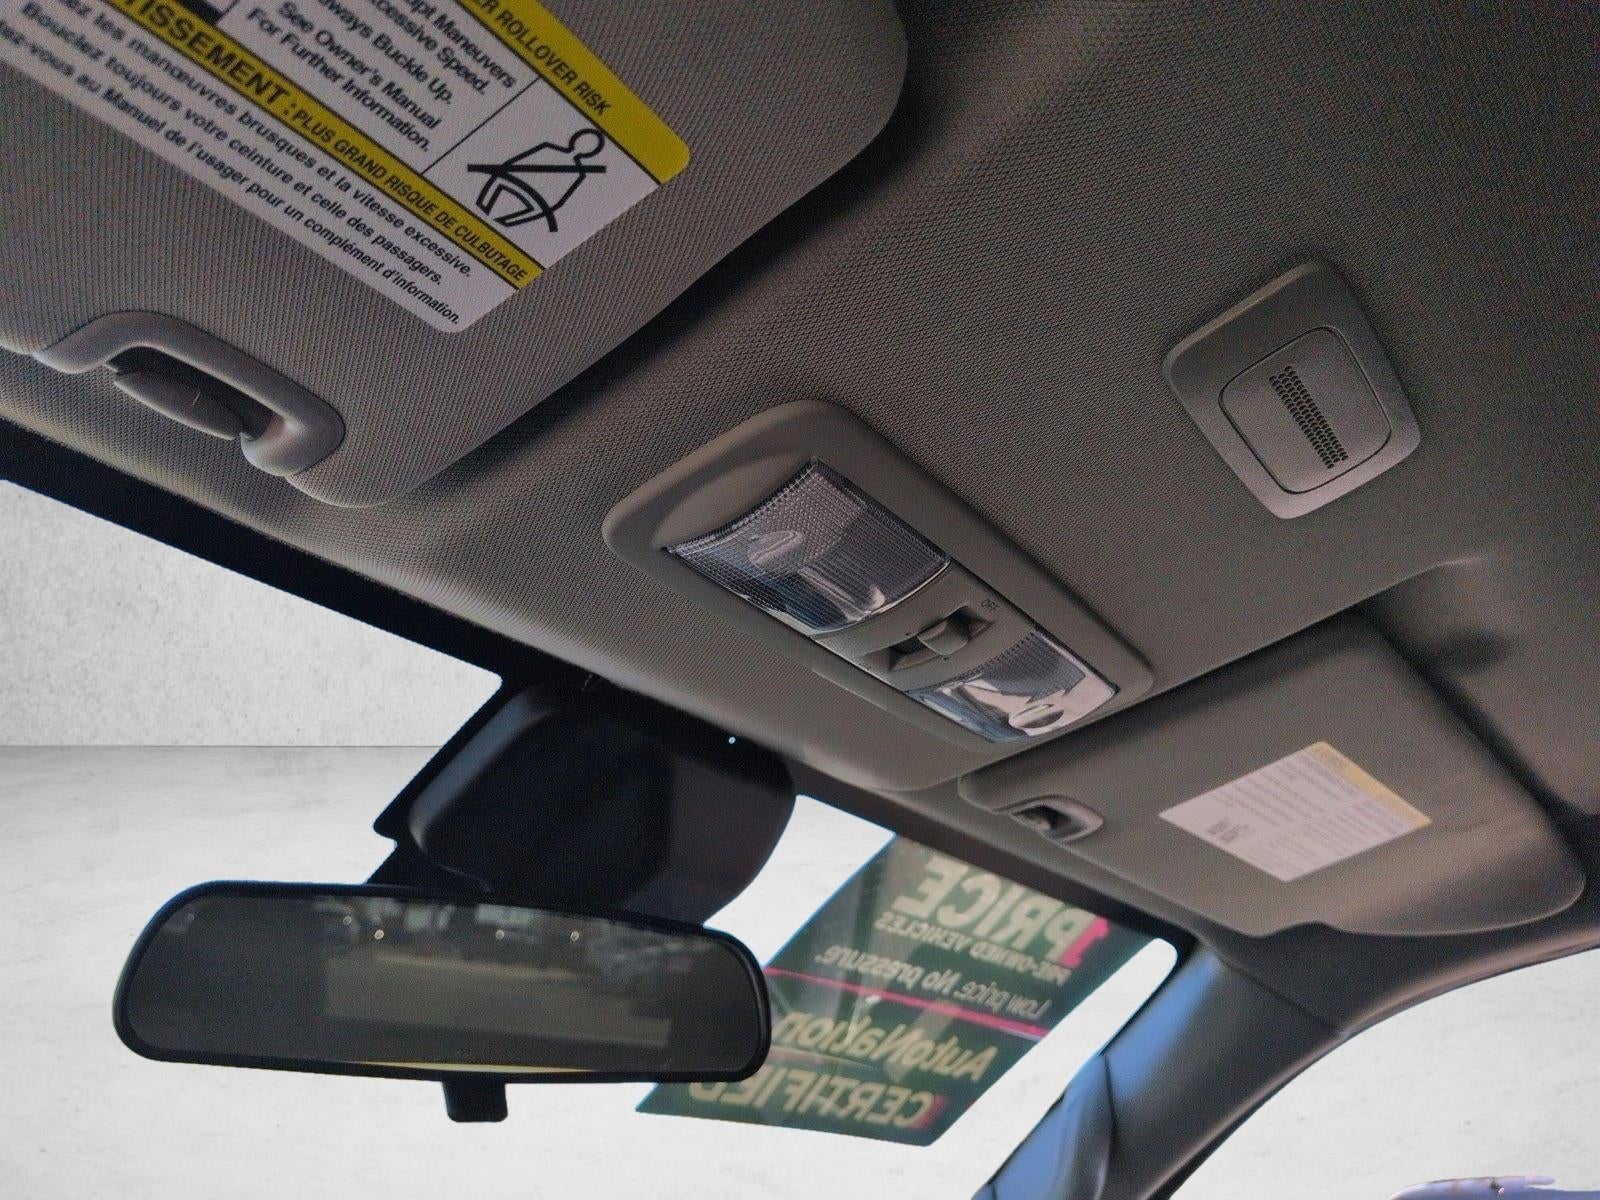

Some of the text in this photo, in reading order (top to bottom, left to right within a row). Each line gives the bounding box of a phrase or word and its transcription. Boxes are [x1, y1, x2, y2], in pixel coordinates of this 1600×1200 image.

[247, 8, 431, 152] For Further Information.
[278, 2, 442, 130] See Owner's Manual
[372, 33, 428, 82] Buckle
[428, 77, 453, 104] Up.
[433, 14, 517, 88] Maneuvers
[437, 47, 490, 94] Speed.
[495, 10, 613, 116] ROLLOVER RISK
[102, 88, 167, 133] Manuel
[165, 128, 188, 147] de
[187, 140, 250, 186] l'usager
[245, 182, 285, 208] pour
[283, 204, 304, 222] un
[304, 218, 385, 273] complément
[382, 267, 460, 325] d'information.
[105, 56, 182, 111] toujours
[184, 108, 229, 141] votre
[229, 138, 294, 184] ceinture
[293, 182, 313, 196] et
[311, 193, 347, 219] celle
[346, 216, 375, 237] des
[371, 235, 442, 285] passagers.
[238, 111, 317, 169] brusques
[317, 166, 337, 182] et
[335, 176, 352, 193] la
[353, 189, 405, 229] vitesse
[404, 225, 471, 278] excessive.
[292, 109, 337, 143] PLUS
[334, 139, 388, 180] GRAND
[384, 175, 439, 216] RISQUE
[434, 211, 457, 229] DE
[454, 224, 529, 281] CULBUTAGE
[981, 599, 1000, 613] OFF
